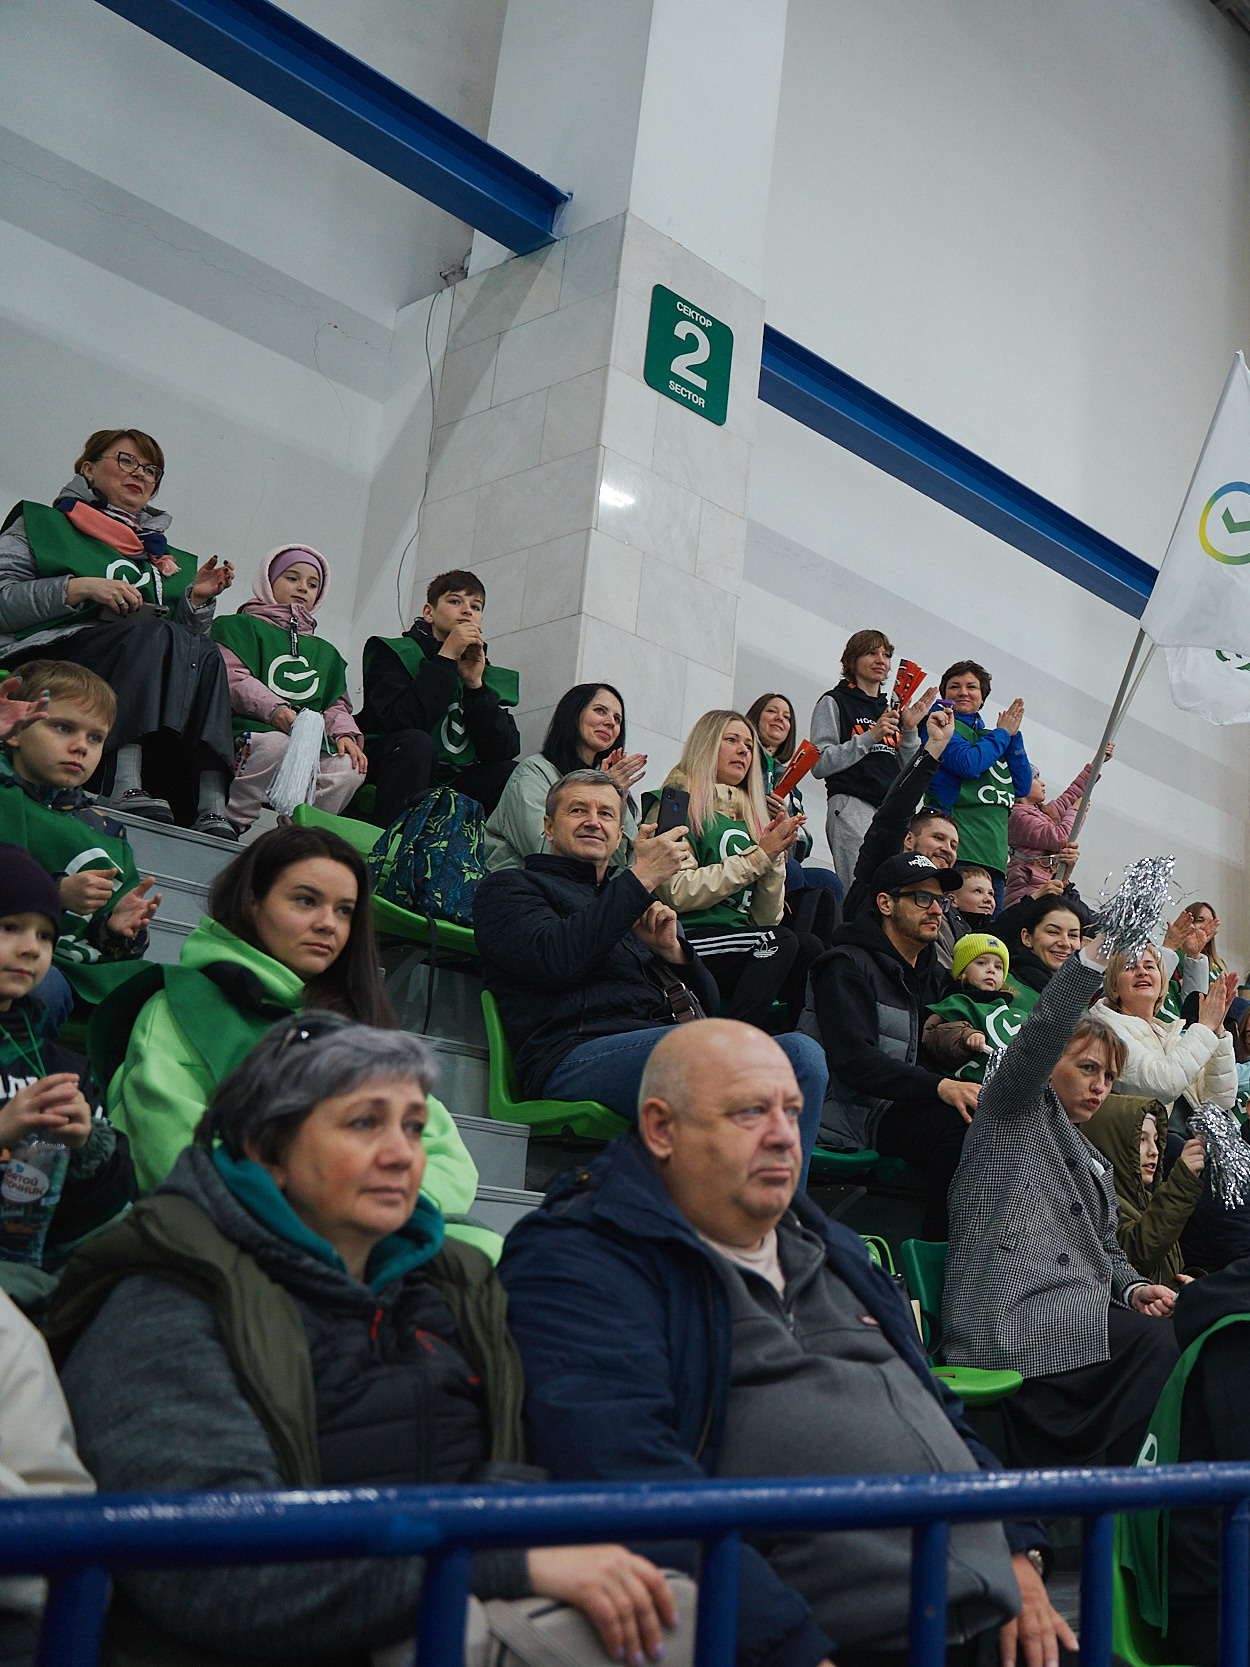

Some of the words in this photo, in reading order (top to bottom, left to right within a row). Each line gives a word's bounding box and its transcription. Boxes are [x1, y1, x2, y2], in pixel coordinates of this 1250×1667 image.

[676, 301, 713, 328] СЕКТОР
[670, 319, 711, 392] 2
[668, 380, 706, 409] SECTOR
